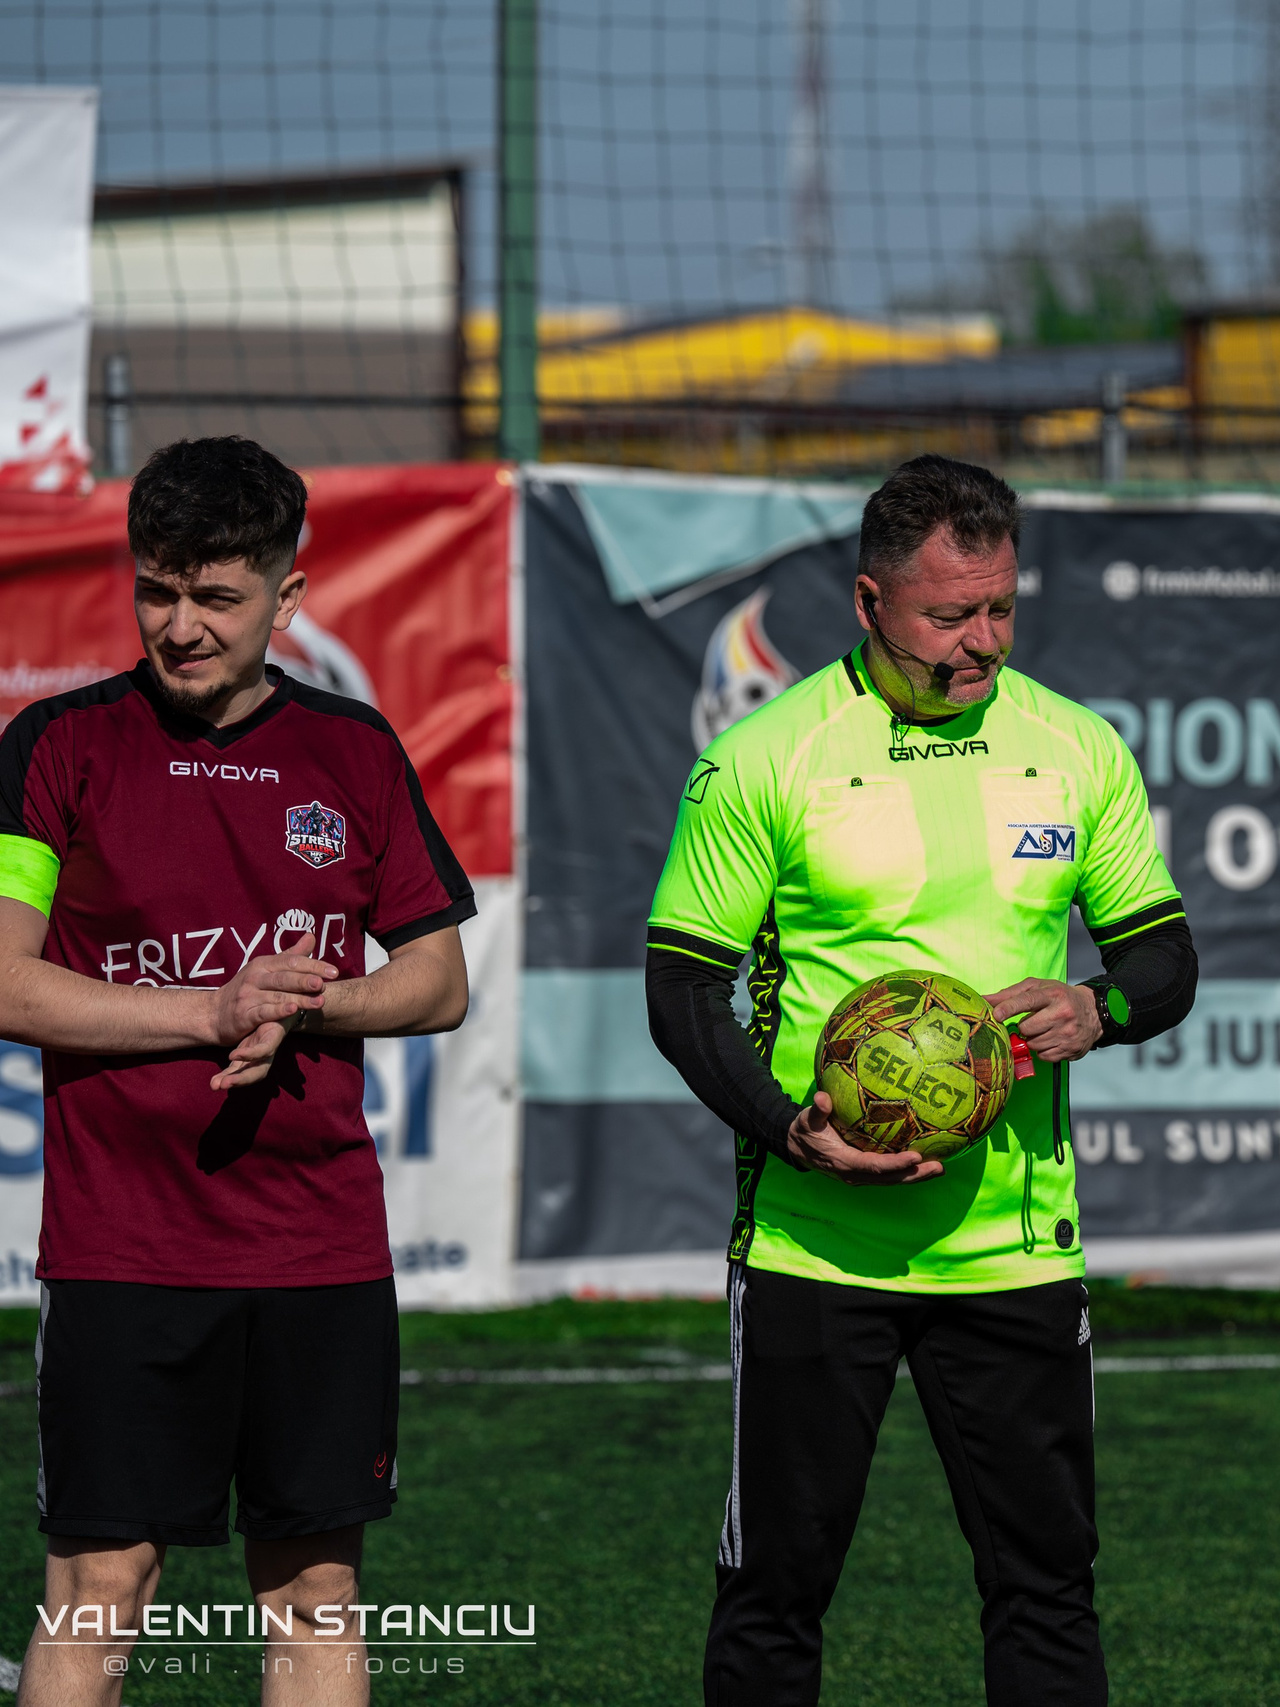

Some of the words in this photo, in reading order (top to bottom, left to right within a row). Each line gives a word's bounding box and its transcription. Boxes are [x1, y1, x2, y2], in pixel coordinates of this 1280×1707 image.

[888, 740, 989, 761] GIVOVA
[169, 761, 280, 784] GIVOVA
[290, 834, 341, 853] STREET
[299, 843, 335, 858] BALLERS
[927, 1018, 963, 1042] AG
[863, 1045, 968, 1118] SELECT
